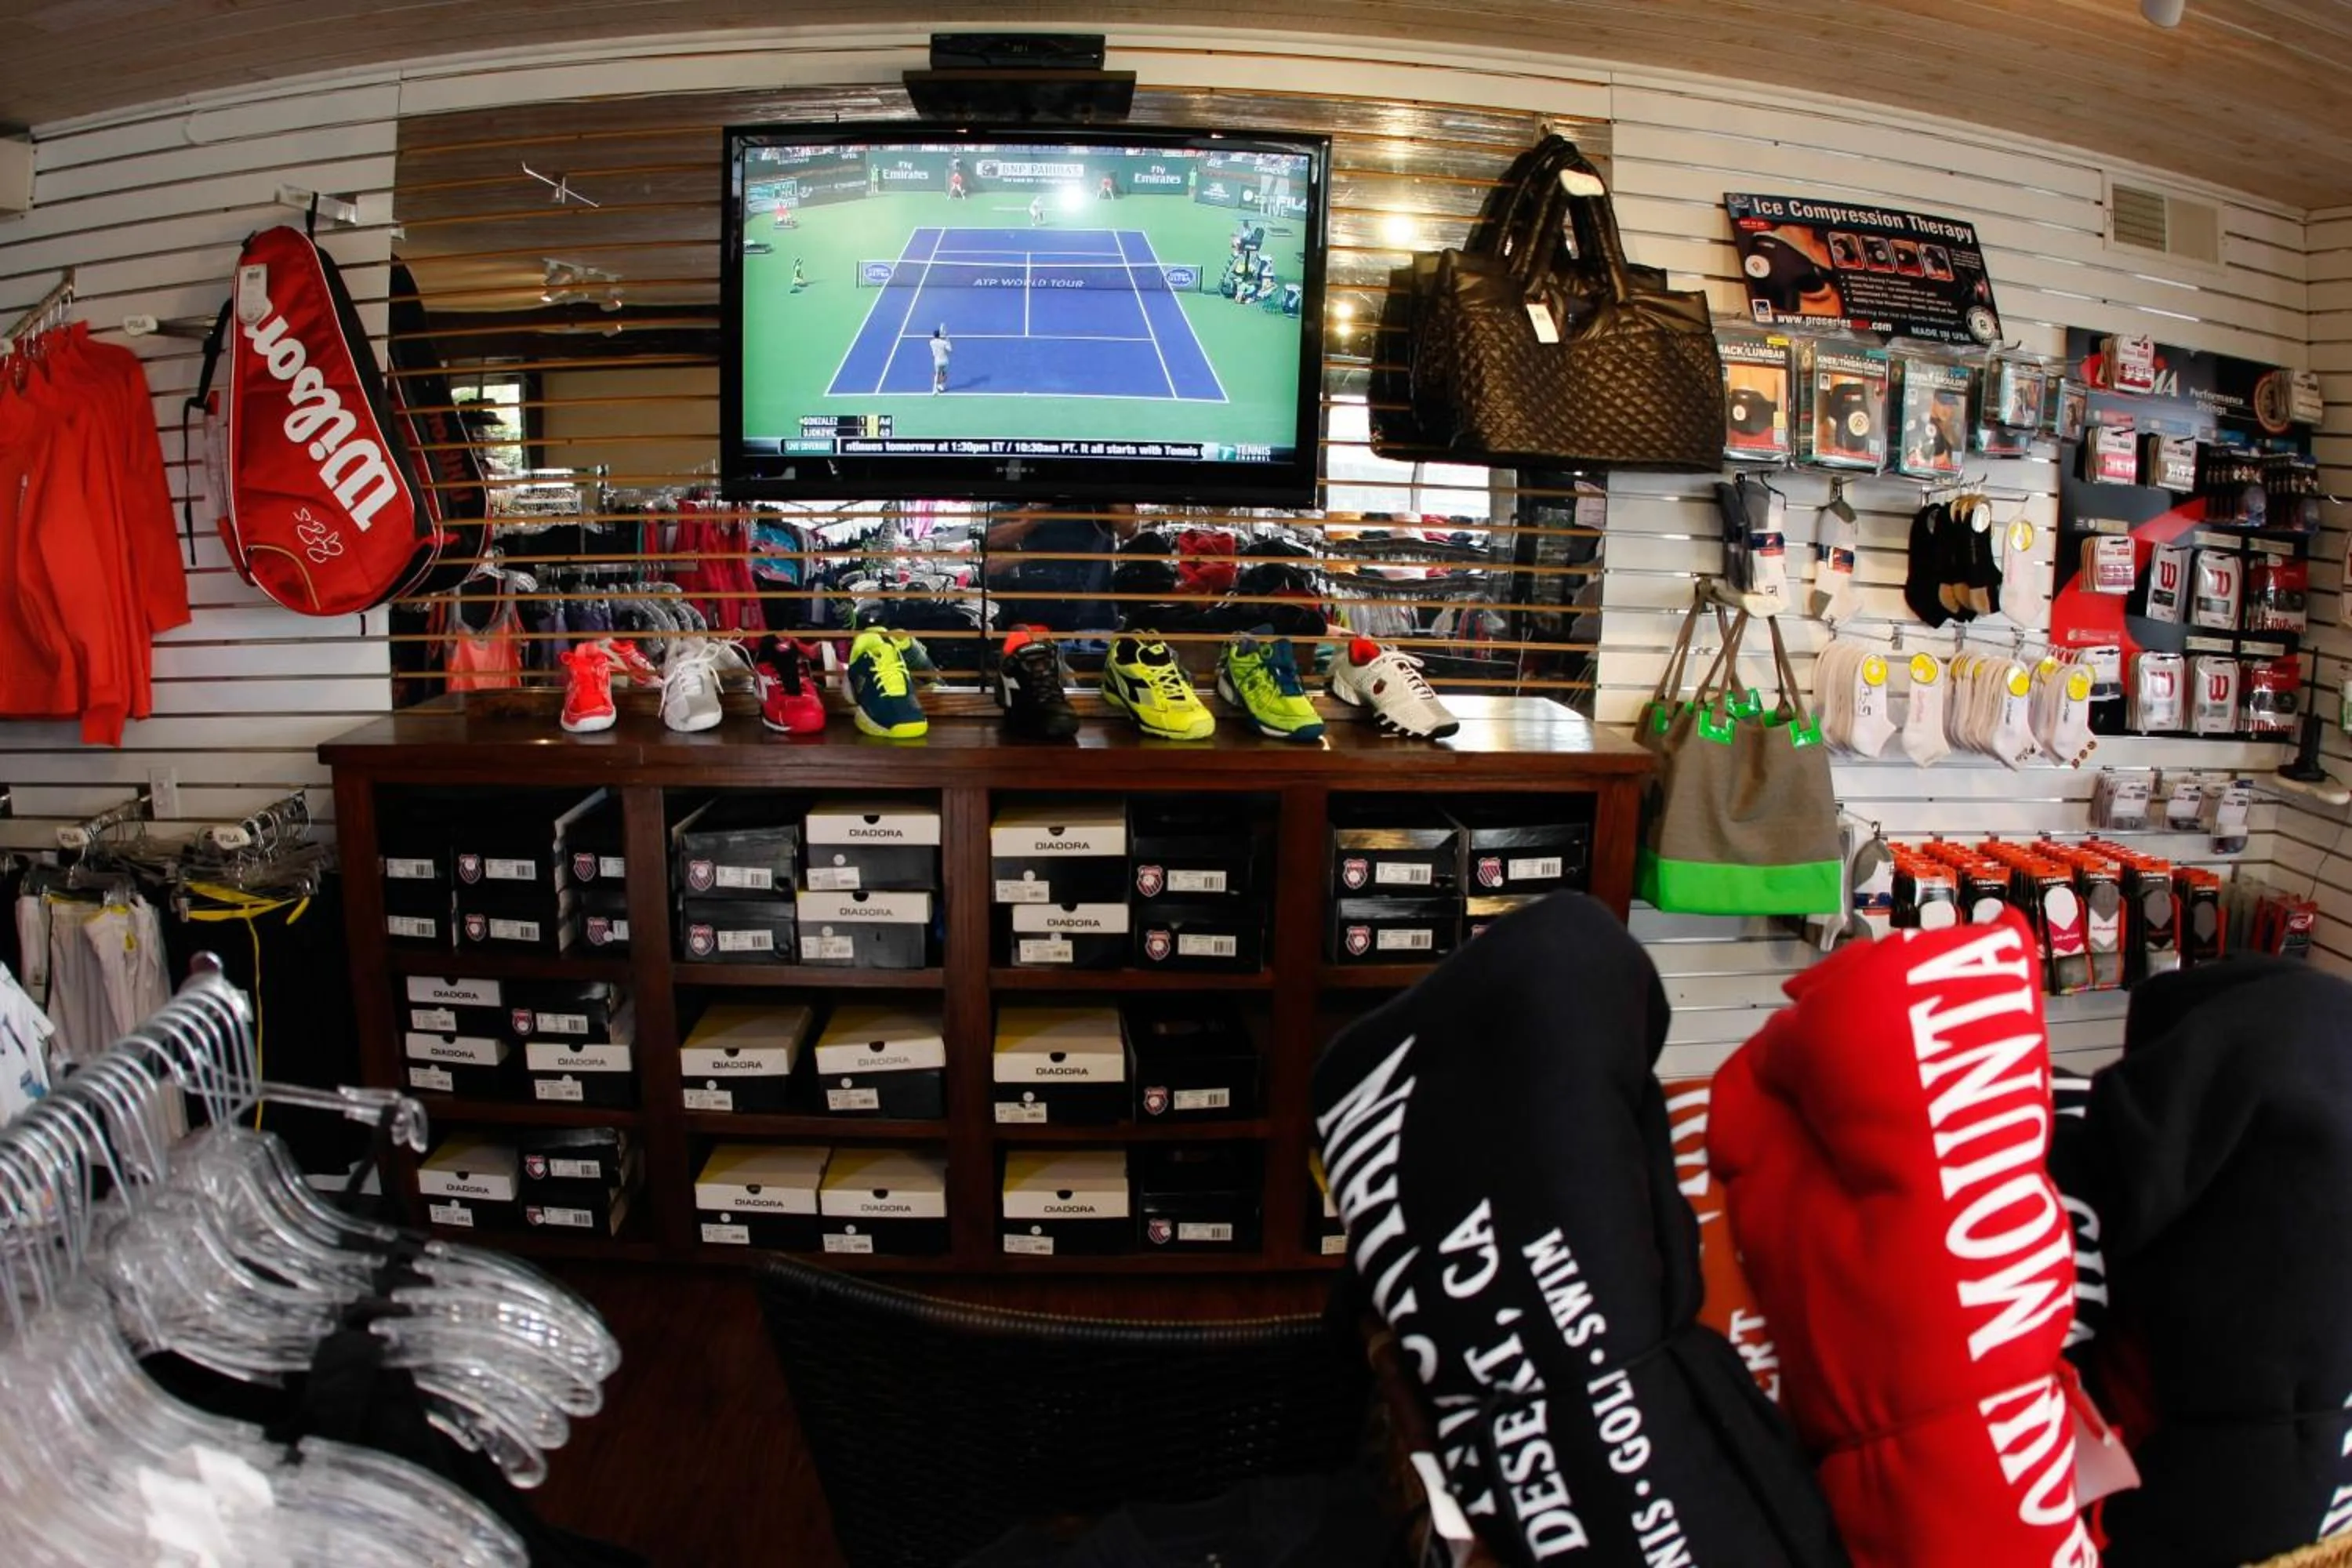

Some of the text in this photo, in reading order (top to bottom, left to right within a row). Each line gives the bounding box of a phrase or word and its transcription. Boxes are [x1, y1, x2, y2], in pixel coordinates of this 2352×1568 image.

[898, 160, 913, 169] Fly
[1151, 165, 1166, 174] Fly
[882, 168, 929, 180] Emirates
[1134, 172, 1181, 184] Emirates
[1752, 197, 1784, 216] Ice
[1789, 201, 1905, 227] Compression
[1907, 215, 1973, 244] Therapy
[973, 278, 998, 287] ATP
[1051, 279, 1085, 289] TOUR
[2190, 387, 2244, 405] Performance
[243, 316, 397, 532] Wilson
[885, 442, 935, 452] tomorrow
[938, 441, 949, 452] at
[951, 441, 989, 454] 1:30pm
[992, 442, 1004, 452] ET
[1014, 442, 1059, 453] 10:30am
[1091, 444, 1105, 455] all
[1106, 445, 1137, 456] starts
[1138, 445, 1163, 456] with
[1164, 445, 1198, 456] Tennis
[1236, 445, 1271, 456] TENNIS
[849, 829, 903, 837] DIADORA
[1035, 841, 1090, 851] DIADORA
[839, 906, 893, 916] DIADORA
[1047, 918, 1101, 928] DIADORA
[434, 989, 479, 1000] DIADORA
[431, 1048, 476, 1059] DIADORA
[558, 1058, 608, 1067] DIADORA
[713, 1060, 763, 1069] DIADORA
[858, 1056, 910, 1067] DIADORA
[1036, 1067, 1088, 1076] DIADORA
[1904, 927, 2075, 1363] MOUNTA
[446, 1184, 490, 1195] DIADORA
[735, 1198, 784, 1208] DIADORA
[861, 1203, 911, 1213] DIADORA
[1044, 1205, 1096, 1214] DIADORA
[1439, 1197, 1499, 1299] CA
[1523, 1227, 1606, 1348] SWIM
